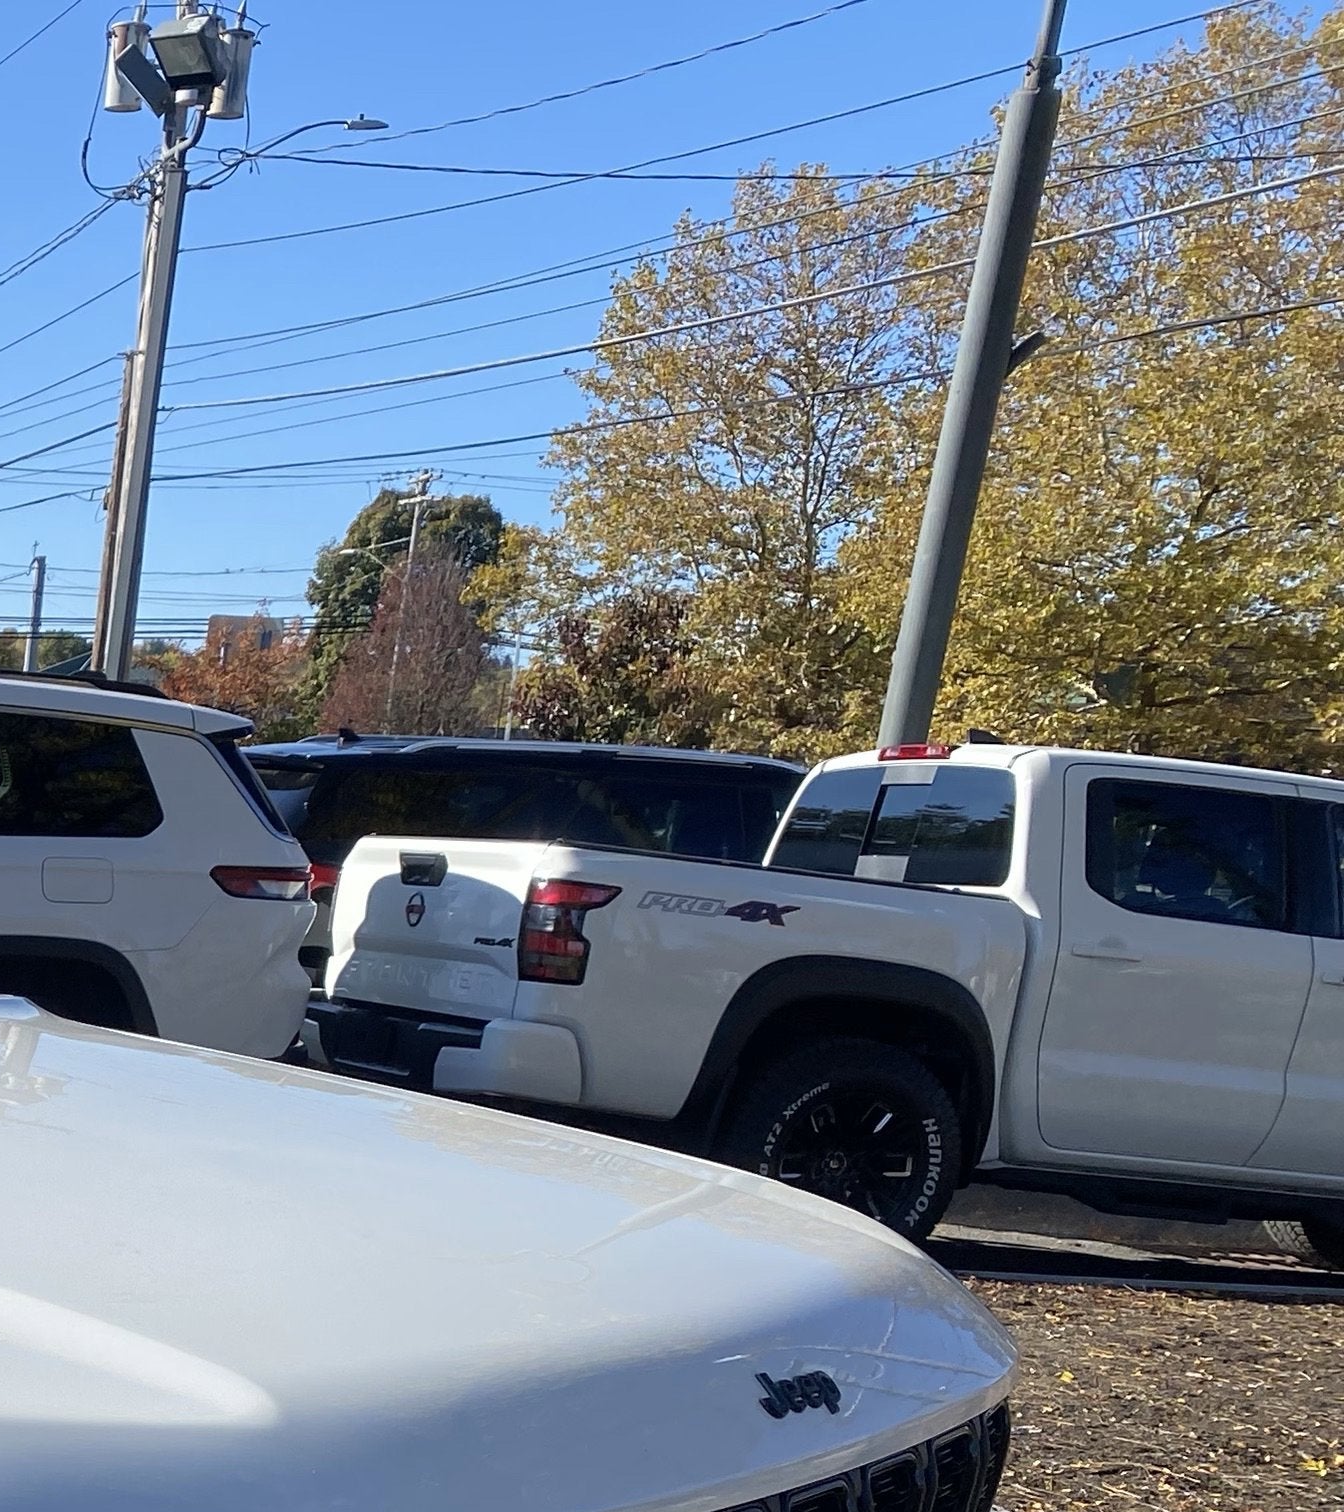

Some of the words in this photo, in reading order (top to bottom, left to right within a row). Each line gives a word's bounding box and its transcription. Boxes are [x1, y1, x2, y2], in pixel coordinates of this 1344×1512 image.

[782, 1082, 830, 1120] Xtreme
[904, 1117, 942, 1227] Hankook
[754, 1370, 841, 1419] Jeep
